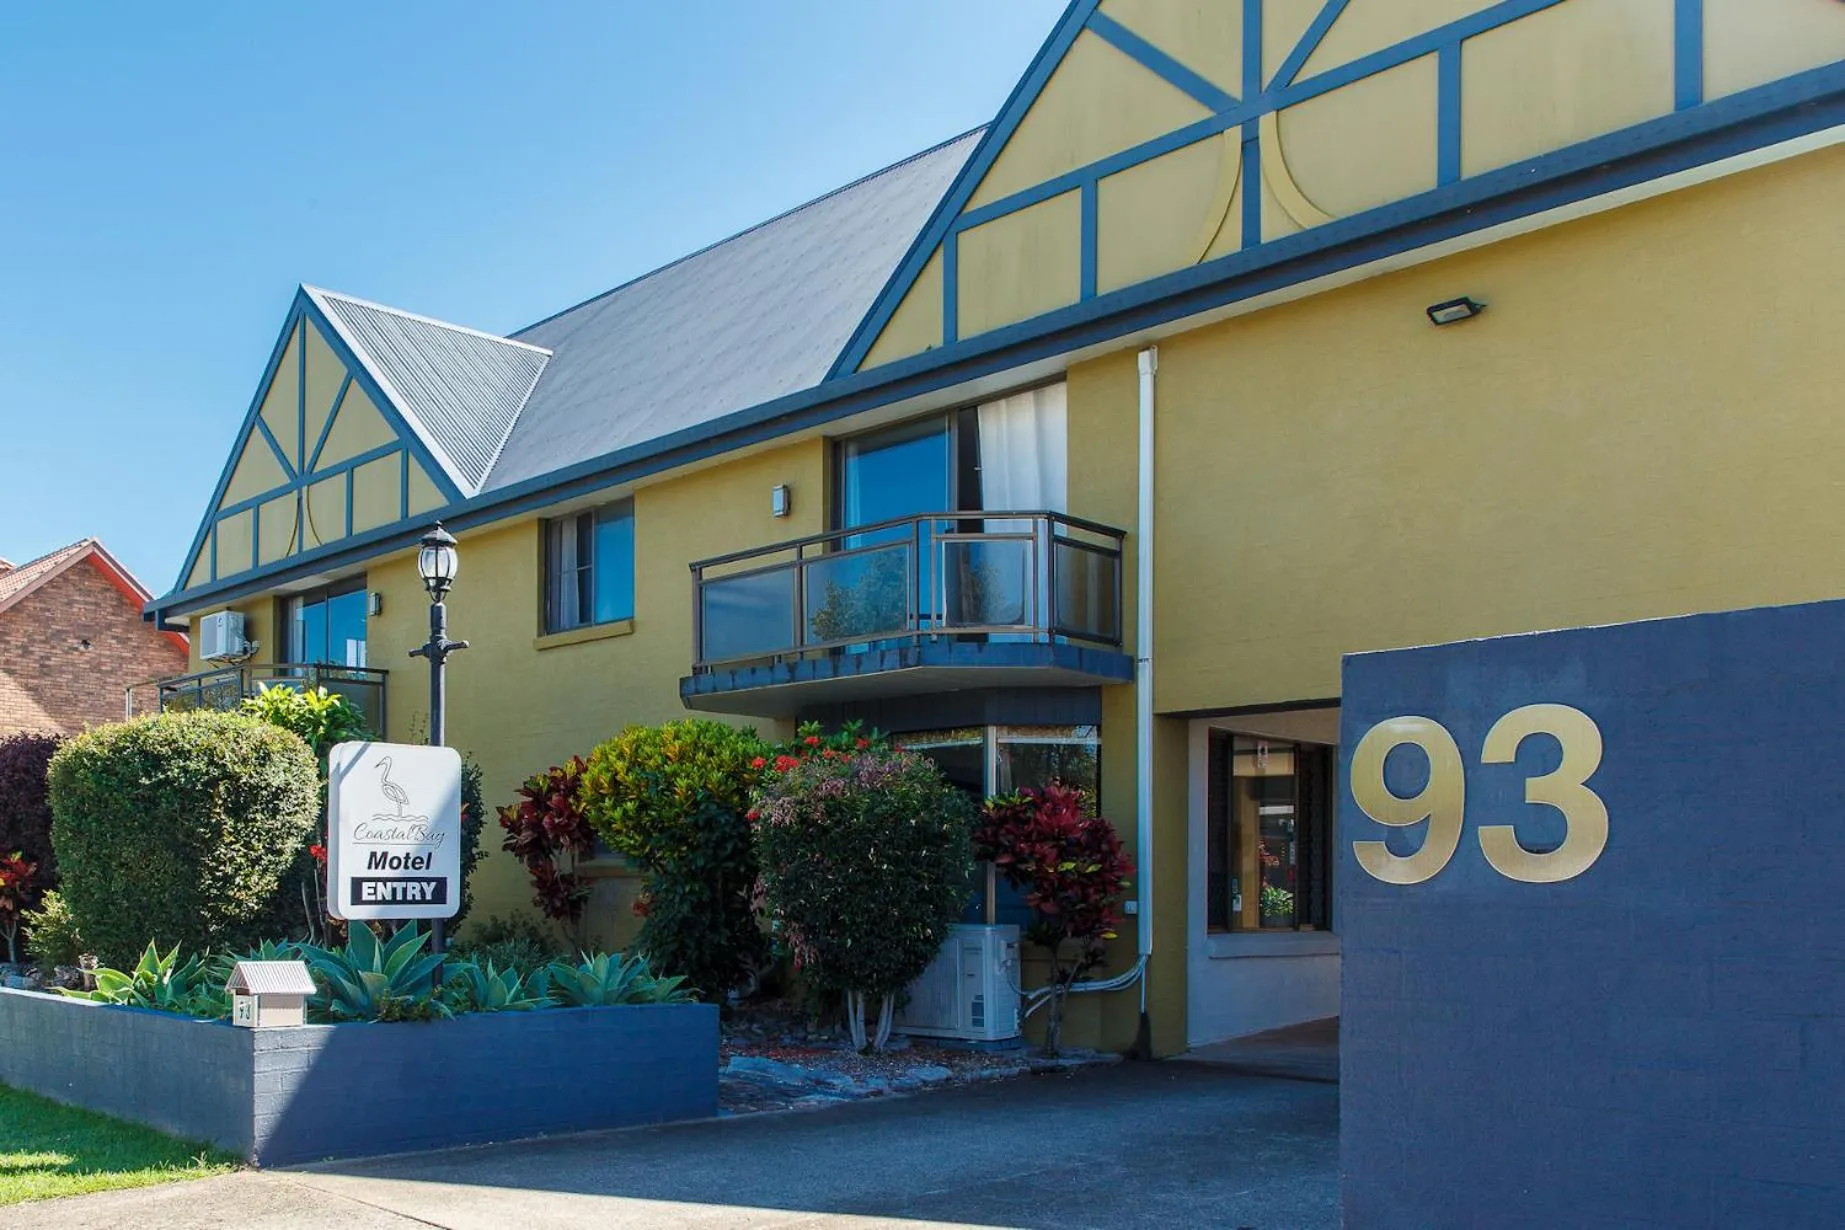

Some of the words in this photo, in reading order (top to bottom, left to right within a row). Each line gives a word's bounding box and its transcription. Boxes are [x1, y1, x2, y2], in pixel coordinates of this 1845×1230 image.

[1350, 703, 1609, 884] 93
[367, 851, 433, 870] Motel
[362, 881, 437, 901] ENTRY
